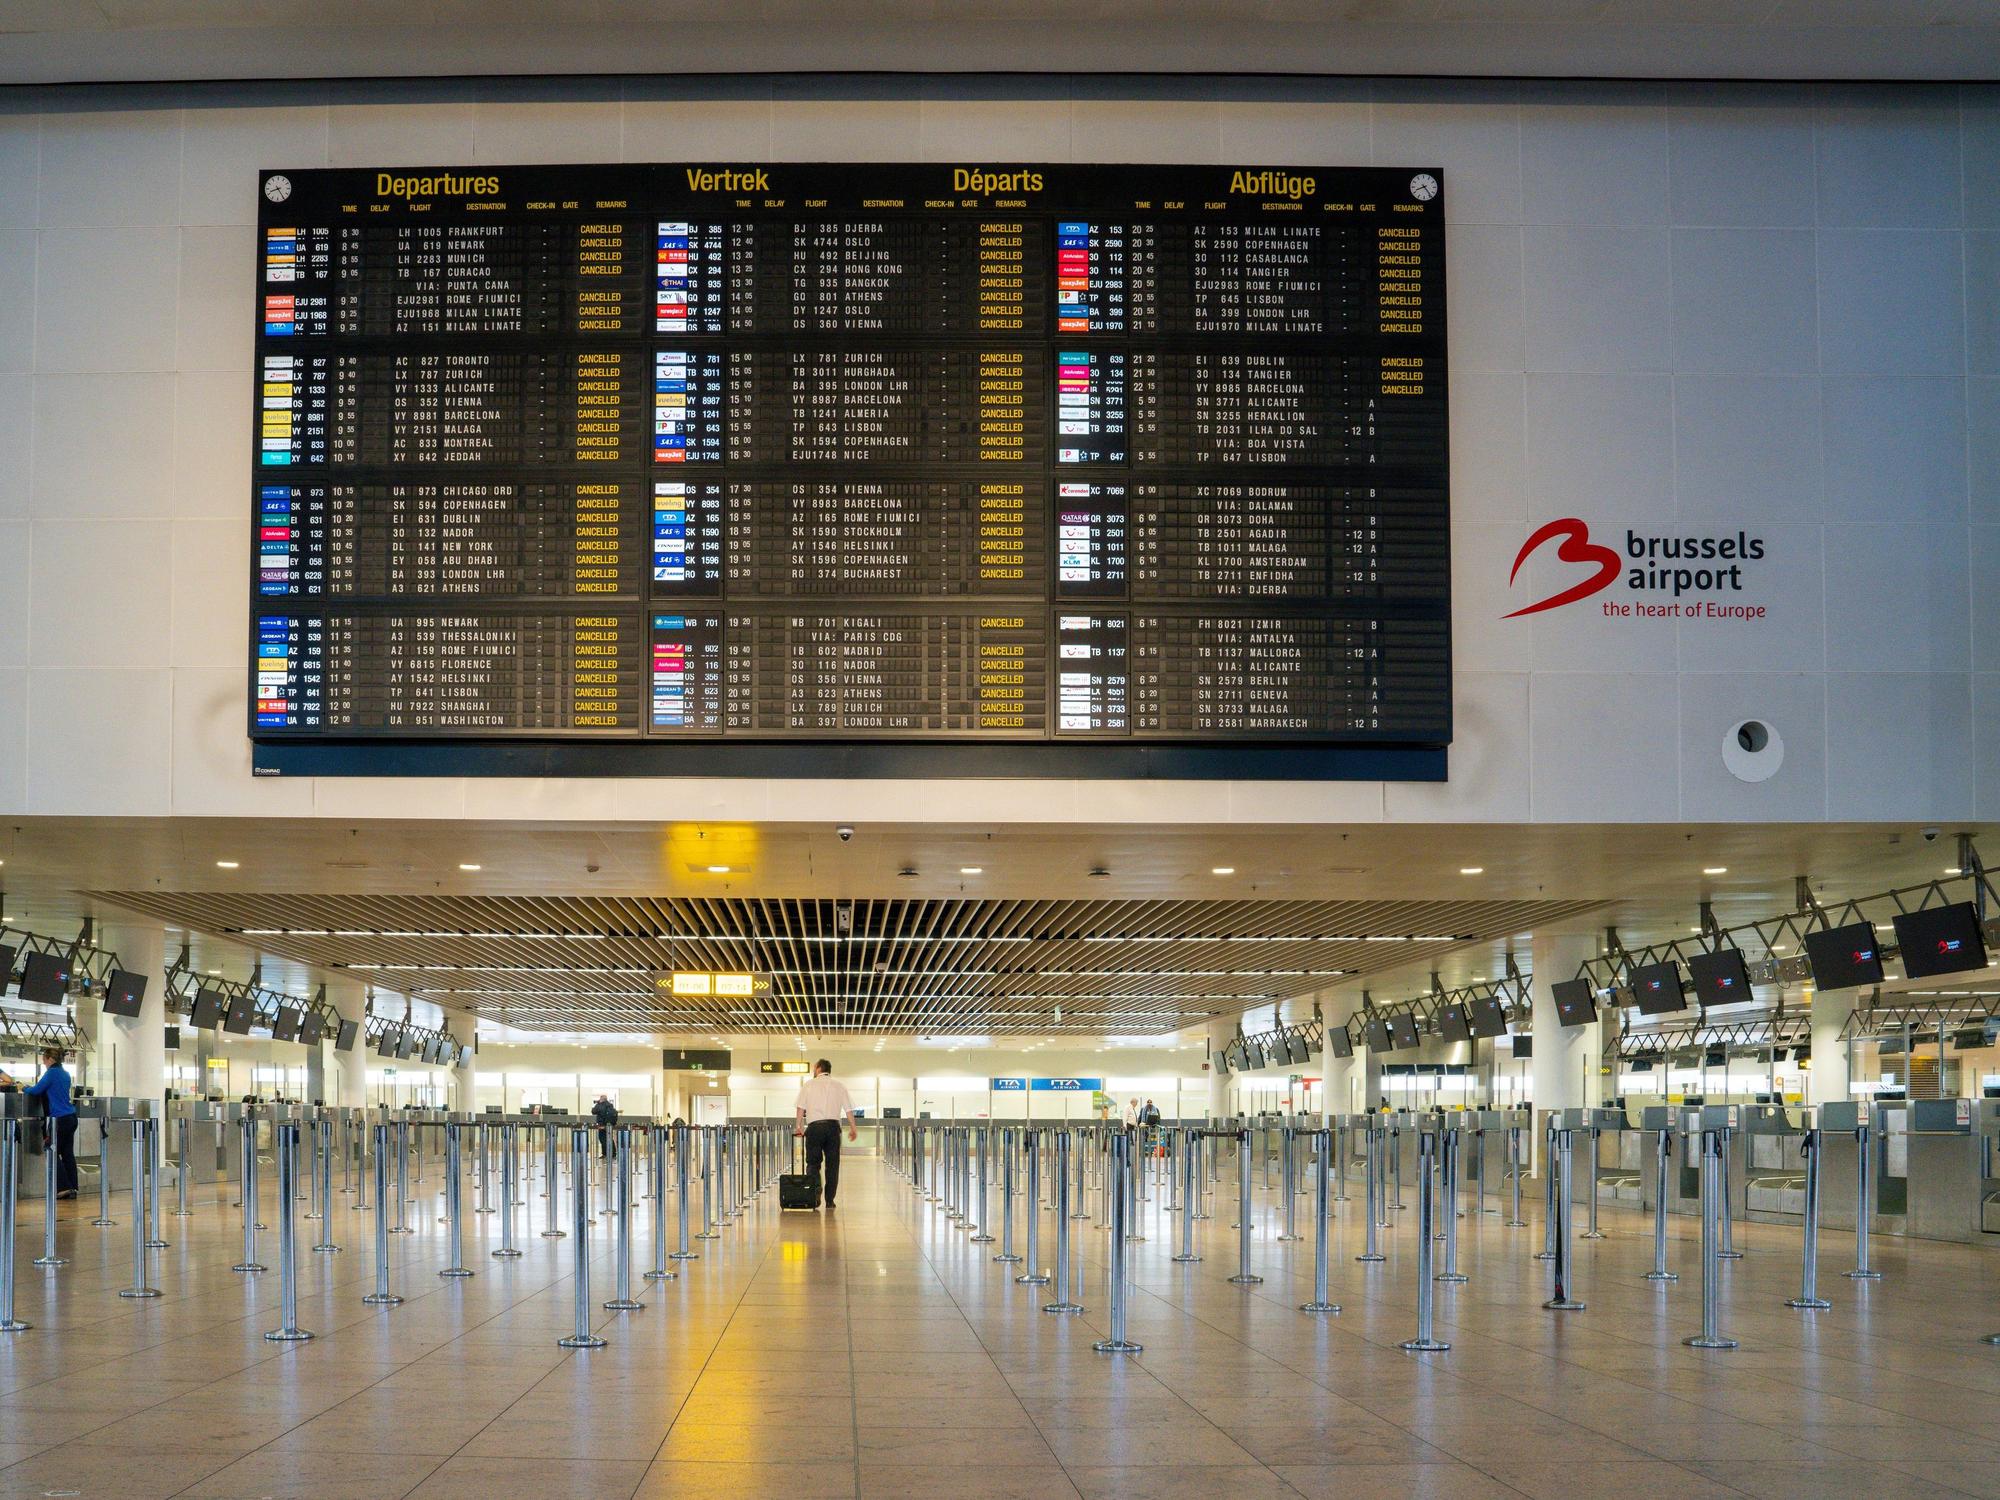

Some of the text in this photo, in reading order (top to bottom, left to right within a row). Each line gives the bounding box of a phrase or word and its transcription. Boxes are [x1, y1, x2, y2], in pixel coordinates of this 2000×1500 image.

[686, 168, 769, 191] Vertrek
[954, 168, 1043, 196] Départs
[377, 173, 499, 200] Departures
[1230, 171, 1316, 200] Abflüge
[370, 204, 390, 212] DELAY
[526, 202, 556, 210] CHECK-IN
[562, 201, 578, 209] GATE
[596, 200, 627, 208] REMARKS
[805, 200, 827, 208] FLIGHT
[925, 200, 954, 208] CHECK-IN
[962, 200, 978, 208] GATE
[995, 200, 1026, 208] REMARKS
[1360, 204, 1376, 212] GATE
[1393, 204, 1424, 212] REMARKS
[399, 224, 622, 237] LH 1005 FRANKFURT CANCELLED
[1194, 240, 1420, 251] SK 2590 COPENHAGEN CANCELLED
[448, 254, 484, 263] MUNICH
[794, 251, 1022, 260] HU 492 BEIJING CANCELLED
[1246, 254, 1308, 264] CASABLANCA
[448, 280, 509, 290] PUNTA CANA
[845, 278, 889, 287] BANGKOK
[1246, 281, 1320, 291] ROME FIUMICI
[397, 292, 621, 304] EJU2981 ROME FIUMICI CANCELLED
[446, 308, 521, 317] MILAN LINATE
[845, 306, 870, 315] OSLO
[1247, 308, 1309, 318] LONDON LHR
[446, 321, 521, 331] MILAN LINATE
[1196, 322, 1422, 332] EJU1970 MILAN LINATE CANCELLED
[395, 382, 620, 393] VY 1333 ALICANTE CANCELLED
[844, 381, 908, 390] LONDON LHR
[1196, 384, 1424, 394] VY 8985 BARCELONA CANCELLED
[793, 395, 1023, 404] VY 8987 BARCELONA CANCELLED
[444, 410, 500, 420] BARCELONA
[844, 409, 889, 418] ALMERIA
[1196, 411, 1304, 421] SN 3255 HERAKLION
[444, 438, 493, 448] MONTREAL
[844, 436, 908, 446] COPENHAGEN
[1248, 439, 1305, 448] BOA VISTA
[444, 452, 481, 461] JEDDAH
[394, 499, 619, 510] SK 594 COPENHAGEN CANCELLED
[443, 514, 480, 523] DUBLIN
[844, 513, 919, 522] ROME FIUMICI
[1249, 515, 1274, 524] DOHA
[792, 527, 1024, 536] SK 1590 STOCKHOLM CANCELLED
[442, 542, 492, 551] NEW YORK
[844, 541, 894, 550] HELSINKI
[1249, 543, 1287, 552] MALAGA
[1627, 530, 1764, 560] brussels
[1198, 557, 1306, 566] KL 1700 AMSTERDAM
[442, 570, 504, 579] LONDON LHR
[844, 569, 901, 578] BUCHAREST
[1250, 571, 1294, 580] ENFIDHA
[1628, 560, 1742, 597] airport
[442, 584, 480, 592] ATHENS
[1603, 601, 1766, 621] the heart of Europe
[792, 618, 1024, 627] WB 701 KIGALI CANCELLED
[391, 632, 618, 641] A3 539 THESSALONIKI CANCELLED
[441, 646, 516, 655] ROME FIUMICI
[844, 646, 882, 656] MADRID
[1198, 648, 1301, 658] TB 1137 MALLORCA
[441, 674, 490, 682] HELSINKI
[844, 674, 882, 684] VIENNA
[1250, 676, 1288, 685] BERLIN
[441, 702, 490, 711] SHANGHAI
[844, 703, 882, 712] ZURICH
[1250, 704, 1288, 714] MALAGA
[441, 716, 504, 725] WASHINGTON
[1199, 718, 1307, 728] TB 2581 MARRAKECH
